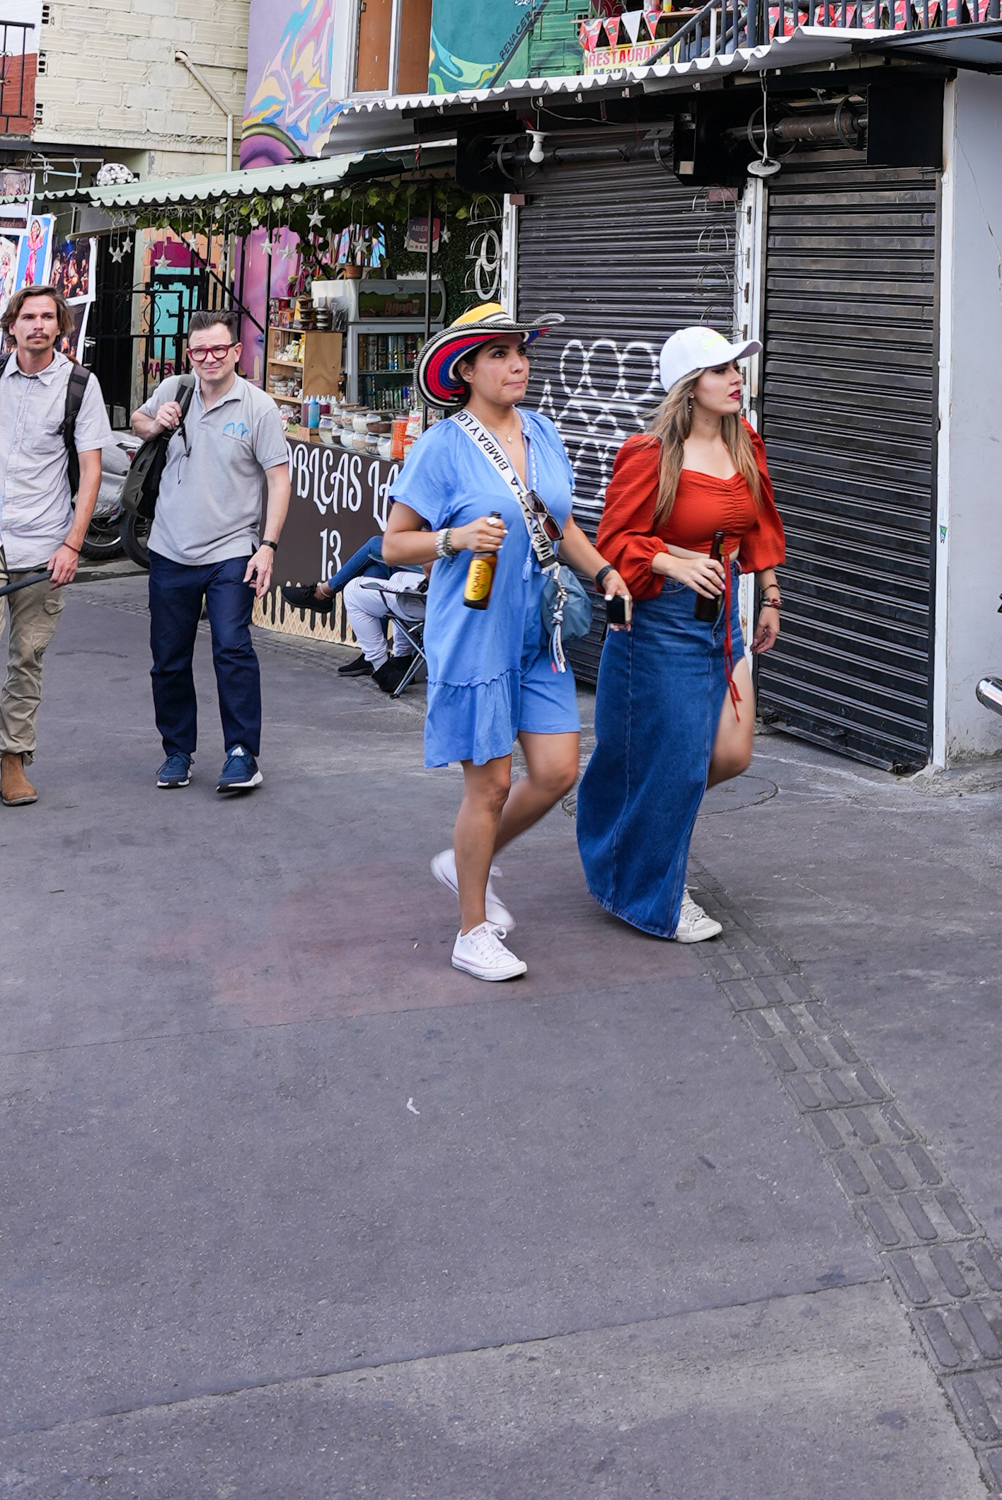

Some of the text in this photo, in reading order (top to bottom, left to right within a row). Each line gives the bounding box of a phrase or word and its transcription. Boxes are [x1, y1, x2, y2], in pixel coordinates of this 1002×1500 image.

[478, 434, 509, 471] BIMBA
[320, 527, 342, 582] 13
[472, 564, 482, 593] POKER
